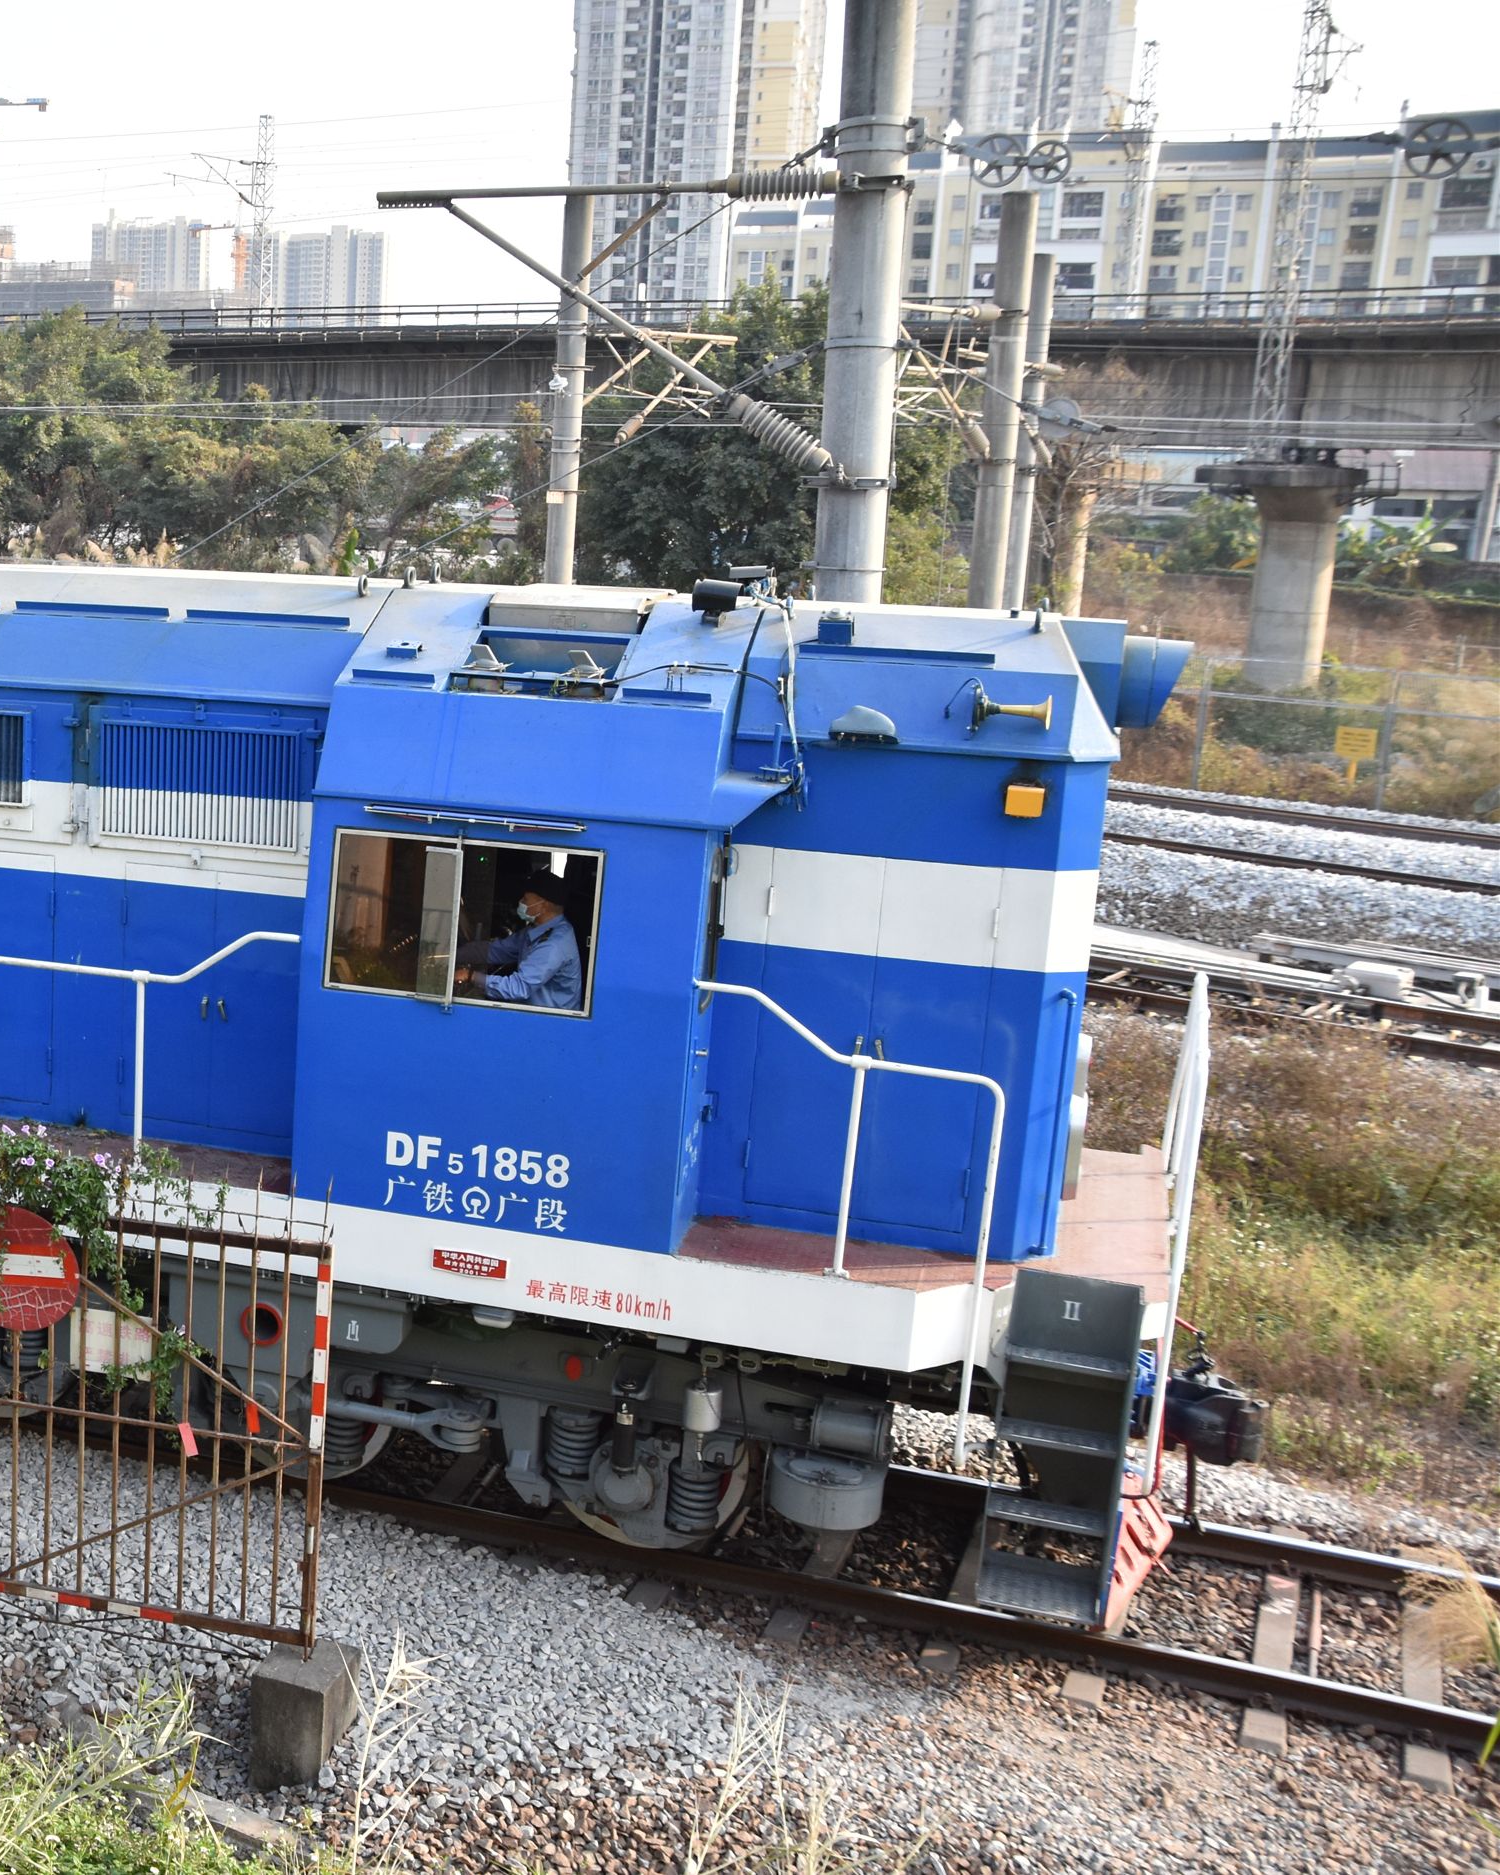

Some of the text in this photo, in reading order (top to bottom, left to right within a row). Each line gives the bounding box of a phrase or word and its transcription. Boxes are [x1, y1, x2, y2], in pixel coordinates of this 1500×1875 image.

[472, 1144, 570, 1189] 1858
[383, 1175, 568, 1232] 广铁 广段
[441, 1251, 499, 1268] 中华人民共和国
